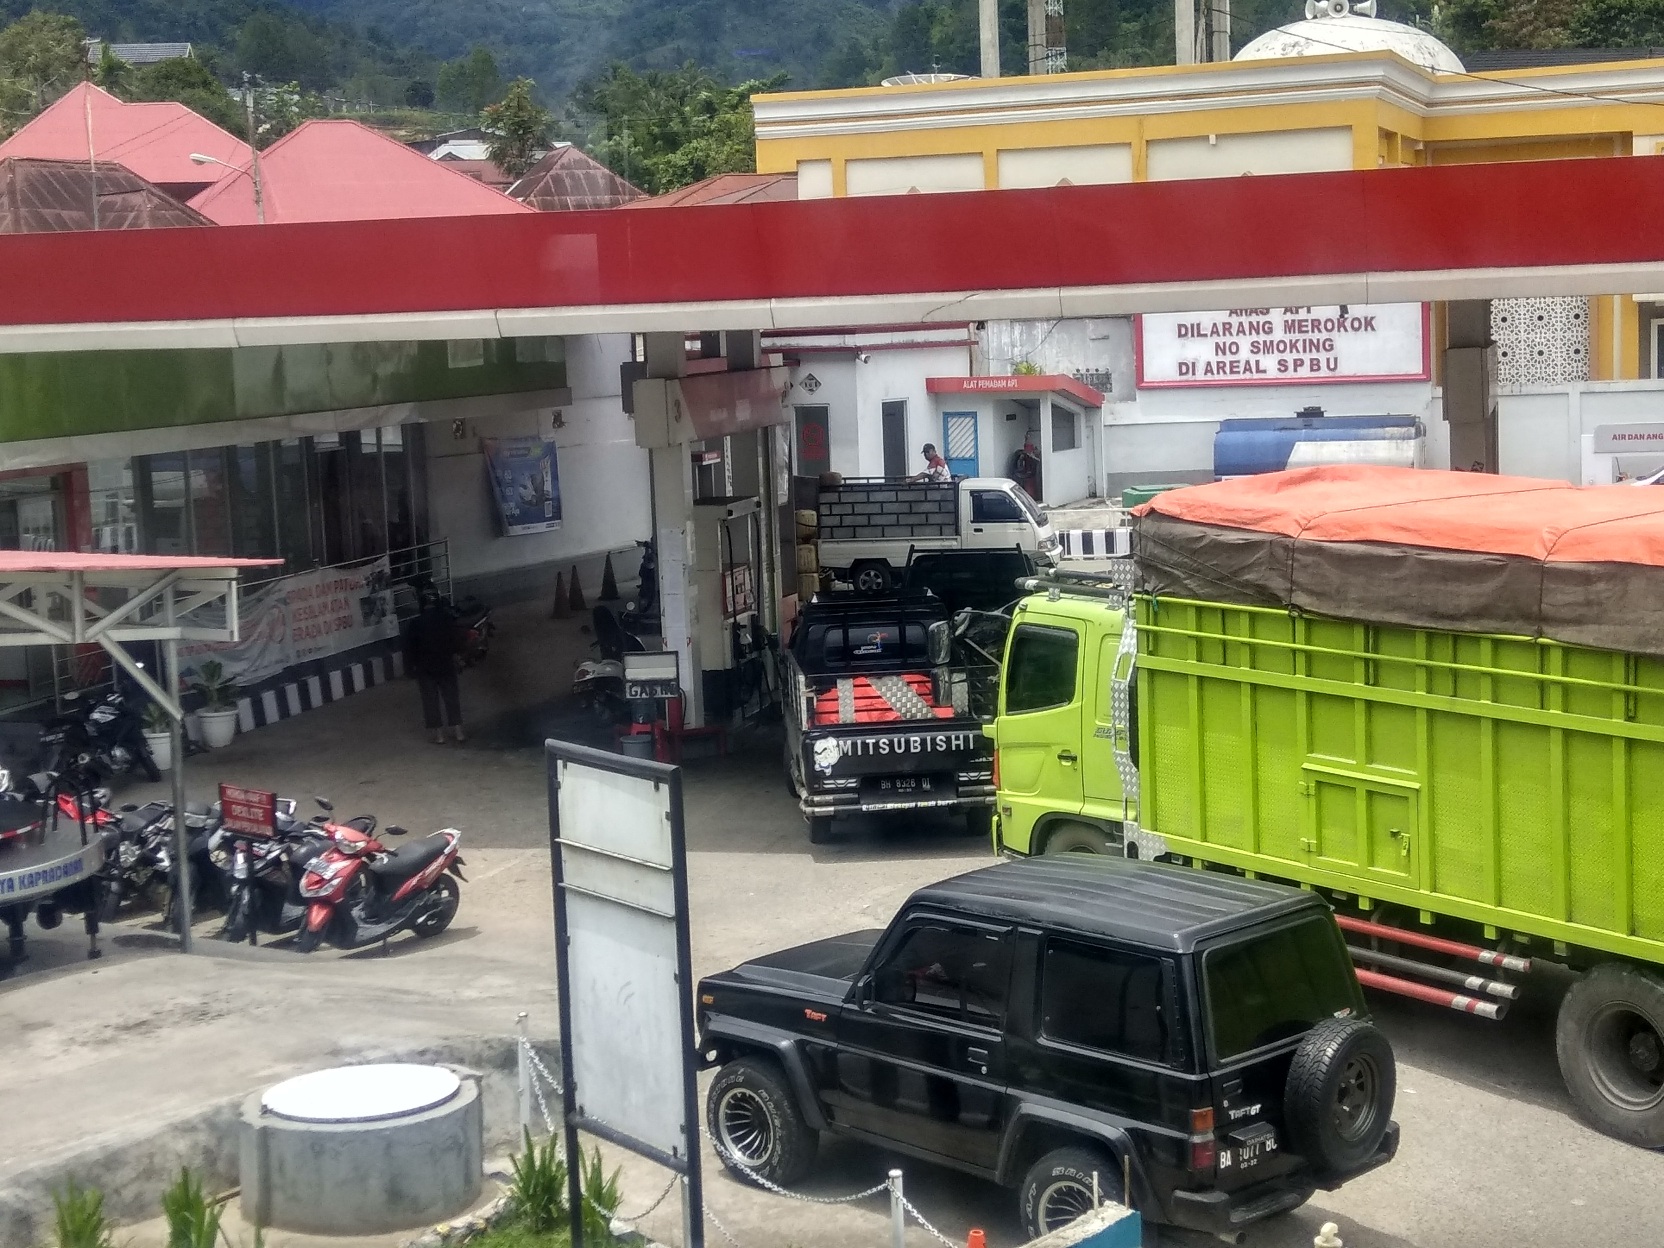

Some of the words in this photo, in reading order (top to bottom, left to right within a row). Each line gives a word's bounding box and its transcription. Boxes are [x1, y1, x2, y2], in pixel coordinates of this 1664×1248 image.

[1177, 320, 1274, 338] DILARANG
[1283, 316, 1376, 334] MEROKOK
[1214, 341, 1240, 356] NO
[1250, 338, 1335, 355] SMOKING
[1178, 361, 1196, 376] DI
[1203, 359, 1267, 375] AREAL
[1277, 357, 1339, 373] SPBU
[963, 380, 977, 389] ALAT
[978, 380, 1006, 389] PEMADAM
[1007, 379, 1018, 388] API
[839, 734, 974, 756] MITSUBISHI
[1228, 1106, 1251, 1120] TAFT
[1250, 1104, 1262, 1116] GT
[1220, 1150, 1232, 1169] BA
